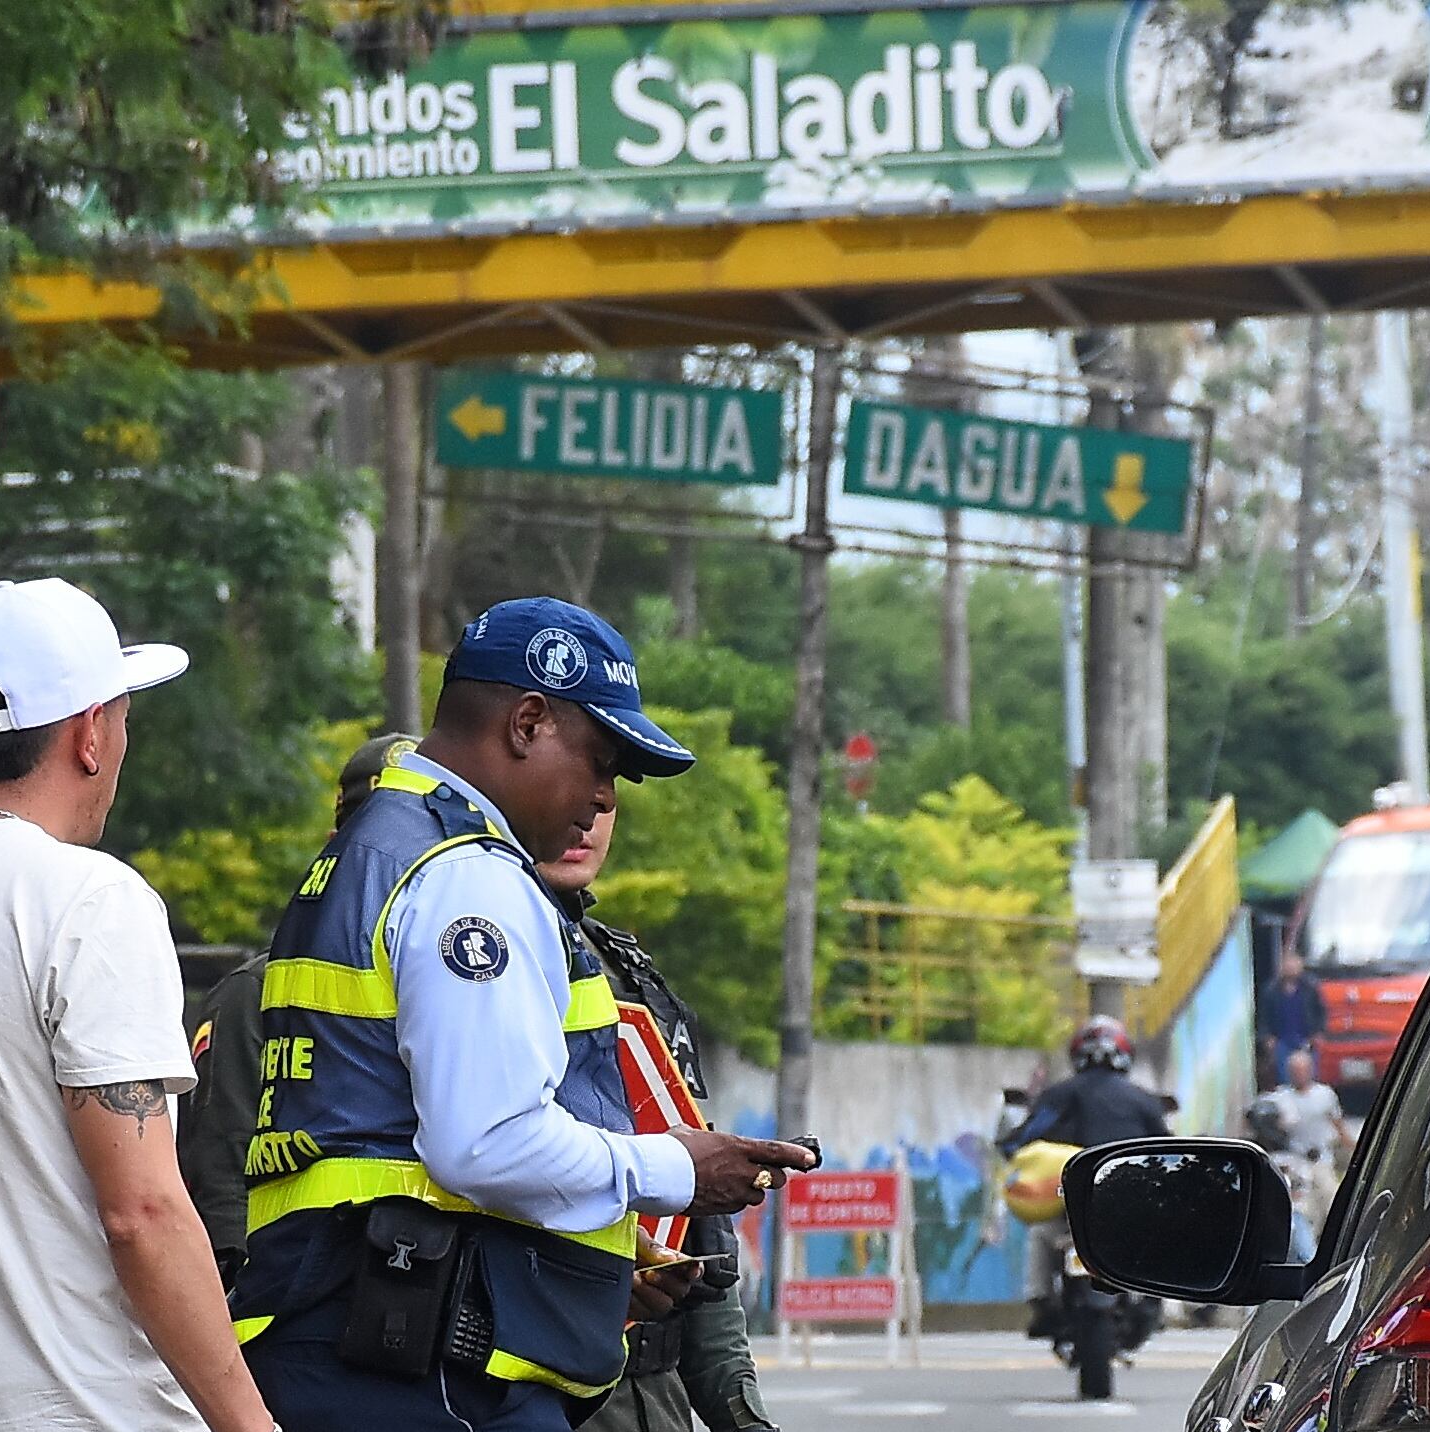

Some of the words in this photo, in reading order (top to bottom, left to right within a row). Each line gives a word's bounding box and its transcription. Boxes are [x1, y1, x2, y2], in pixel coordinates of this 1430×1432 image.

[281, 69, 478, 139] enidos
[488, 61, 580, 173] El
[611, 41, 1056, 168] Saladito
[272, 130, 480, 191] egimiento
[519, 384, 756, 476] FELIDIA
[861, 408, 1087, 515] DAGUA
[545, 676, 562, 687] CALI
[603, 660, 639, 691] MOV
[442, 923, 461, 956] AGENTES
[461, 918, 473, 928] DE
[476, 918, 506, 950] TRANSITO
[474, 971, 495, 981] CALI
